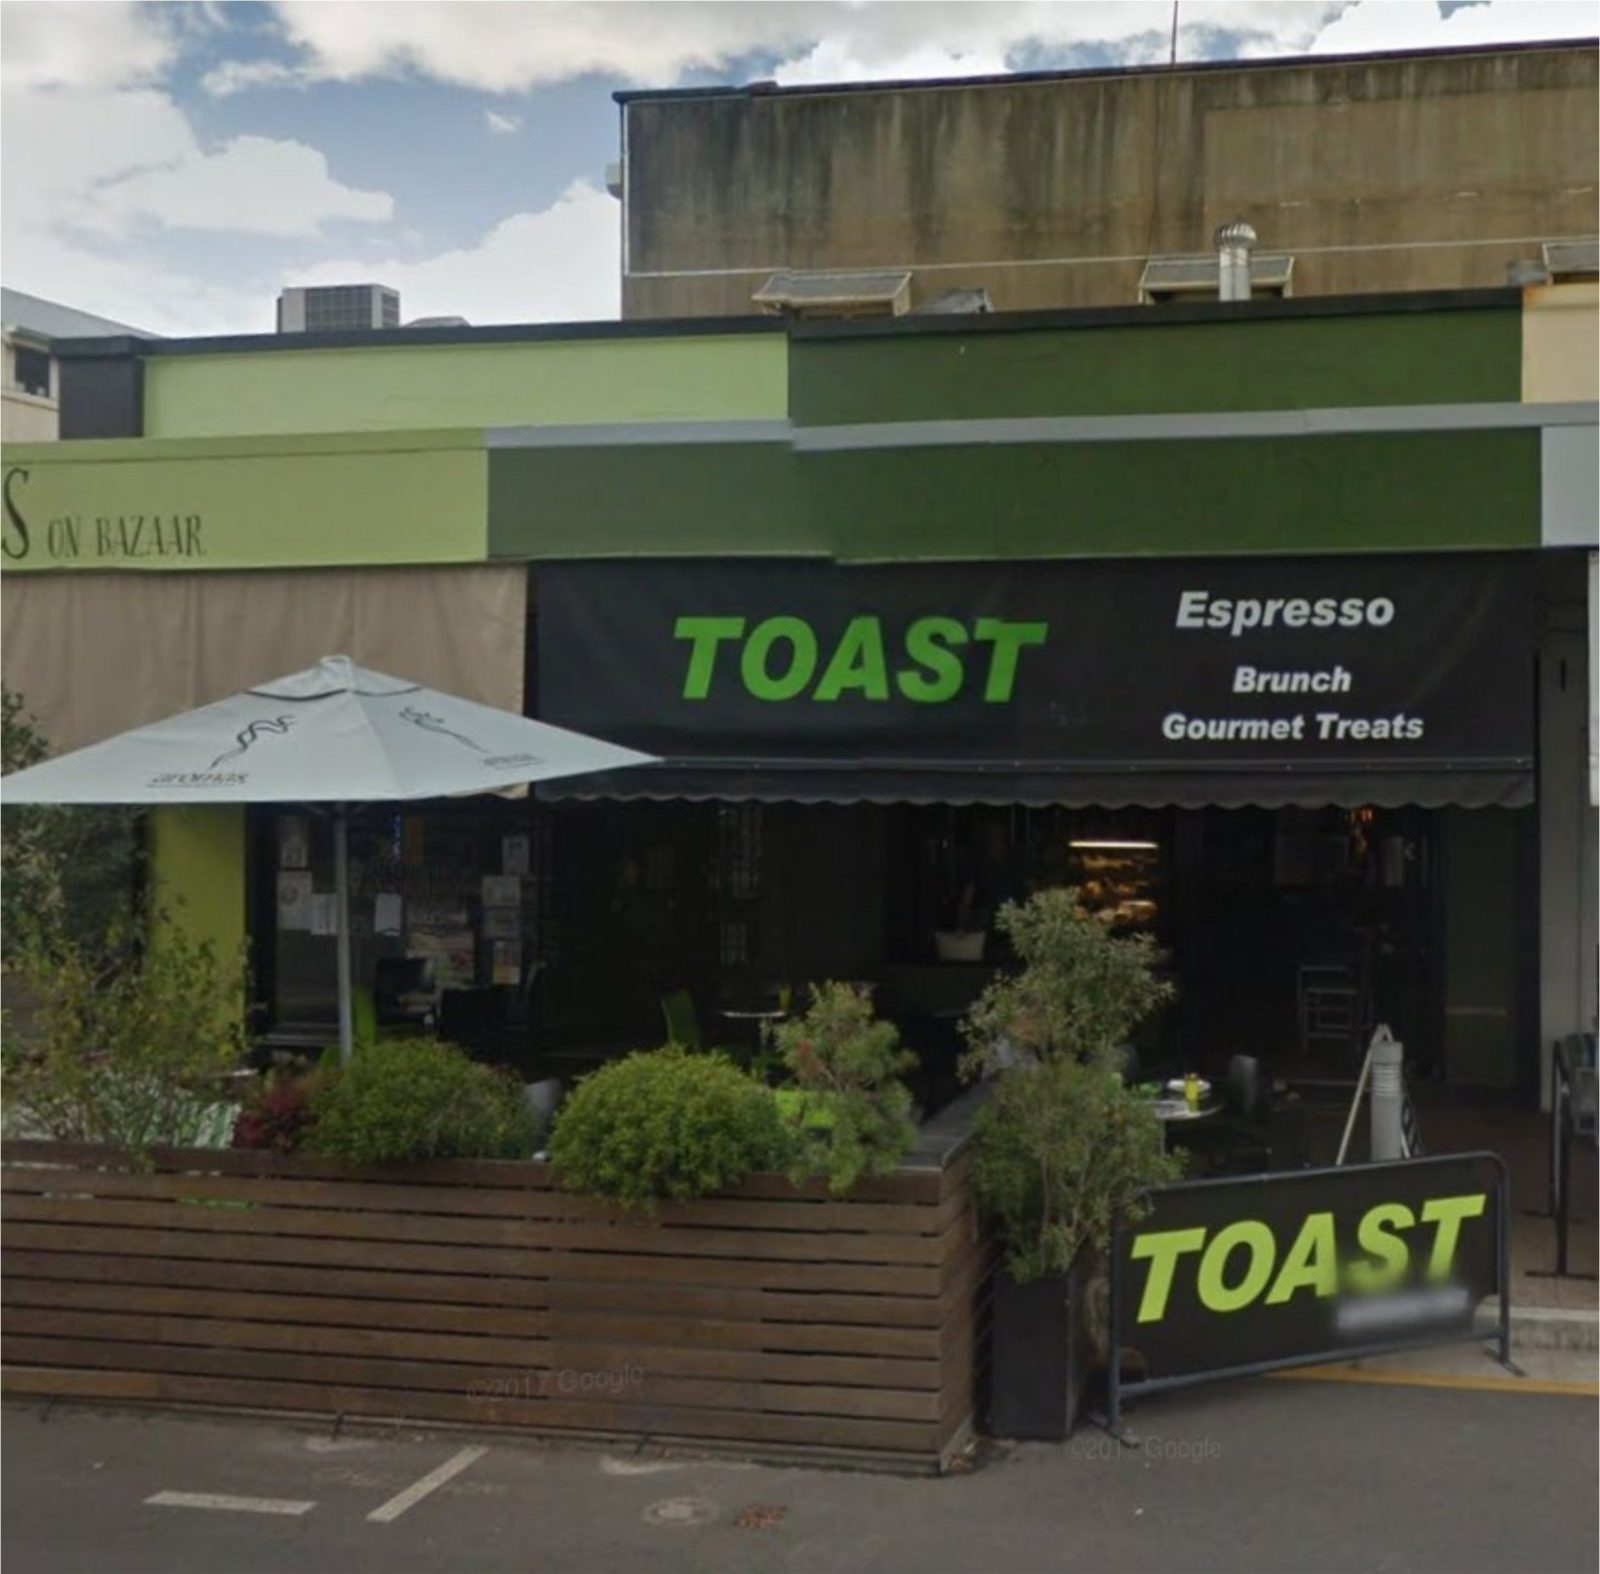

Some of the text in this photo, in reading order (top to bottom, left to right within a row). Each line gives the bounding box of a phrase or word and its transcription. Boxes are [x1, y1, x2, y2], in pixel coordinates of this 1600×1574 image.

[47, 514, 206, 557] ON BAZAAR
[1176, 591, 1395, 636] Espresso
[673, 615, 1048, 703] TOAST
[1232, 666, 1352, 693] Brunch
[1162, 713, 1424, 740] Gourmet Treats
[1130, 1194, 1486, 1324] TOAST
